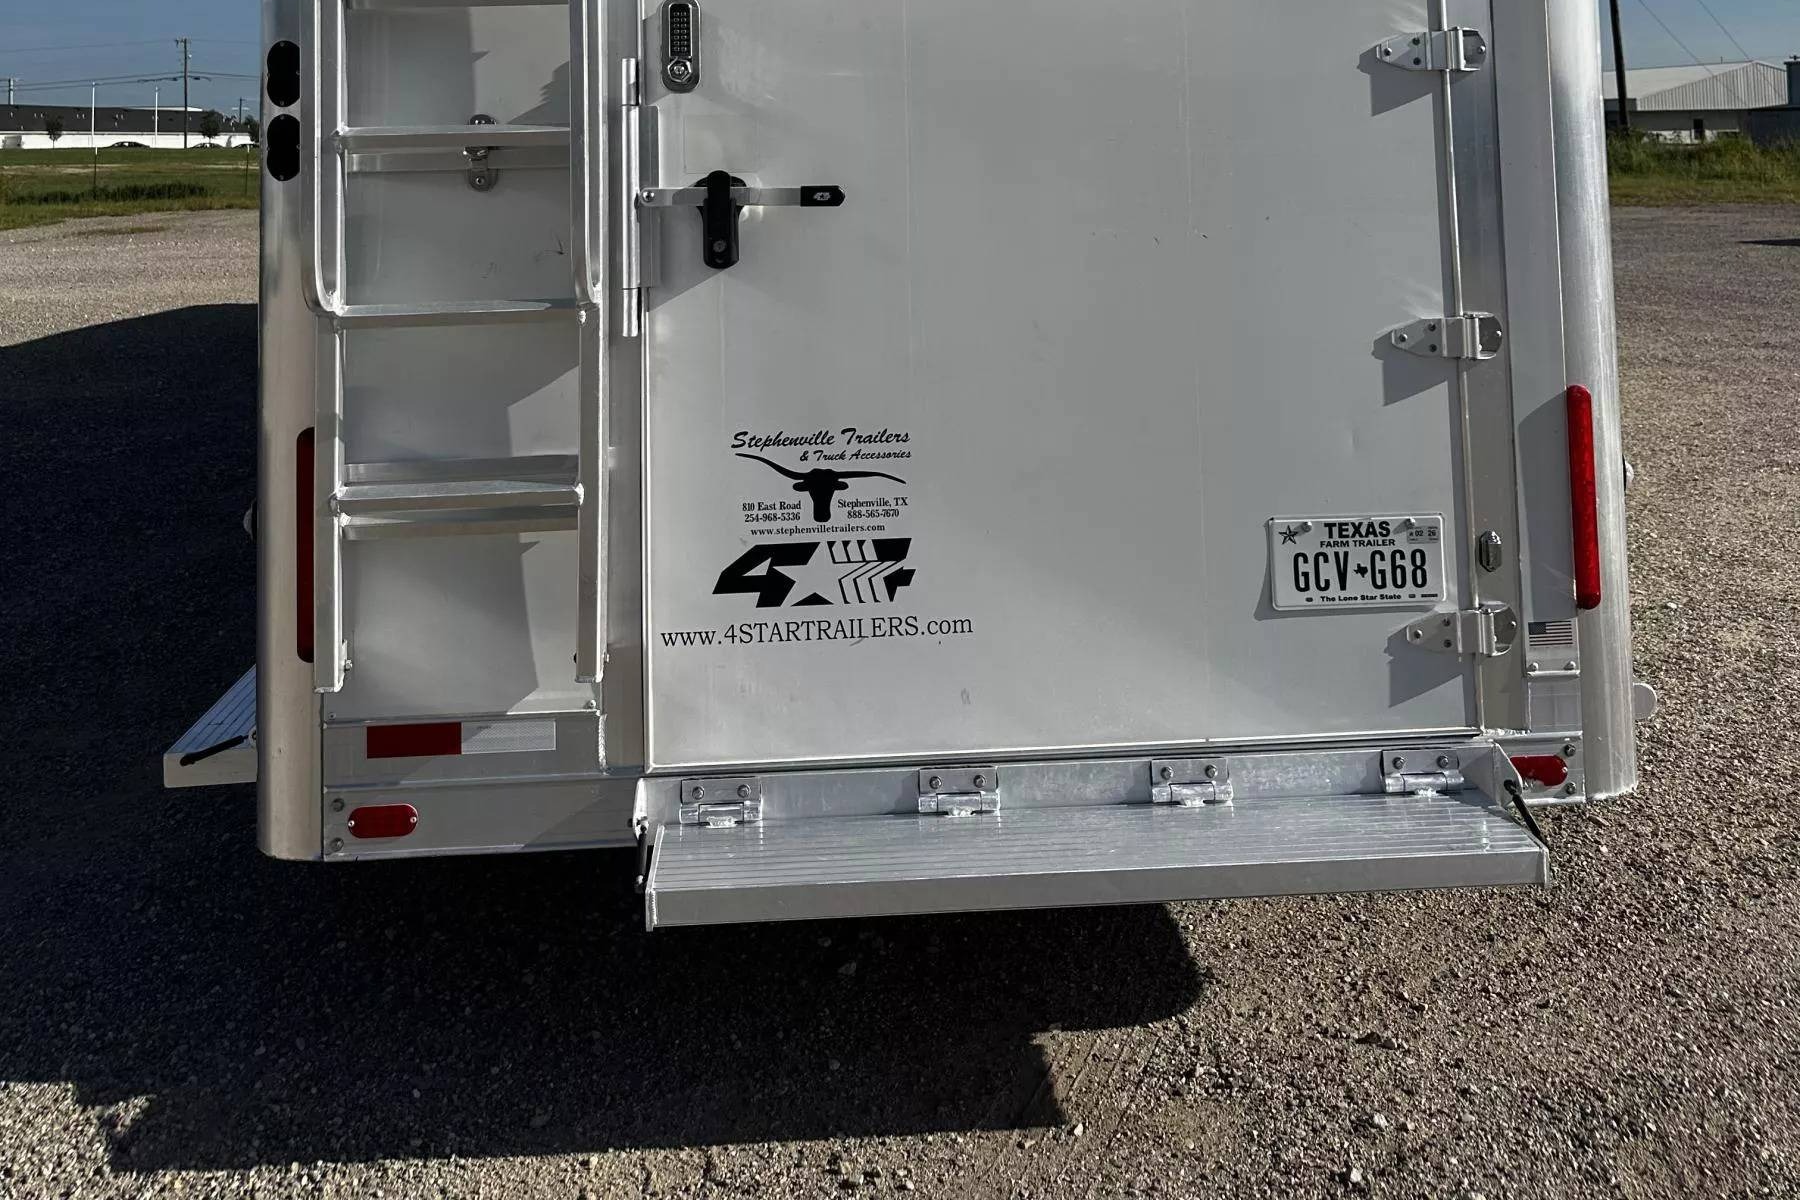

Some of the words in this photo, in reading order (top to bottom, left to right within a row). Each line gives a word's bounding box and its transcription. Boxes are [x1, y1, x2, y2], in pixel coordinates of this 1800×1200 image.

[731, 431, 835, 451] Stephenville
[841, 427, 910, 446] Trailers
[799, 450, 809, 461] &
[813, 450, 846, 461] Truck
[849, 449, 911, 461] Accessories
[757, 501, 776, 511] East
[779, 500, 801, 511] Road
[837, 498, 892, 510] Stephenville,
[894, 497, 908, 506] TX
[750, 524, 885, 536] www.stephenvilletrailers.com
[1324, 520, 1391, 539] TEXAS
[1319, 540, 1350, 549] FARM
[1353, 538, 1396, 548] TRAILER
[661, 616, 973, 646] www.4STARTRAILERS.com
